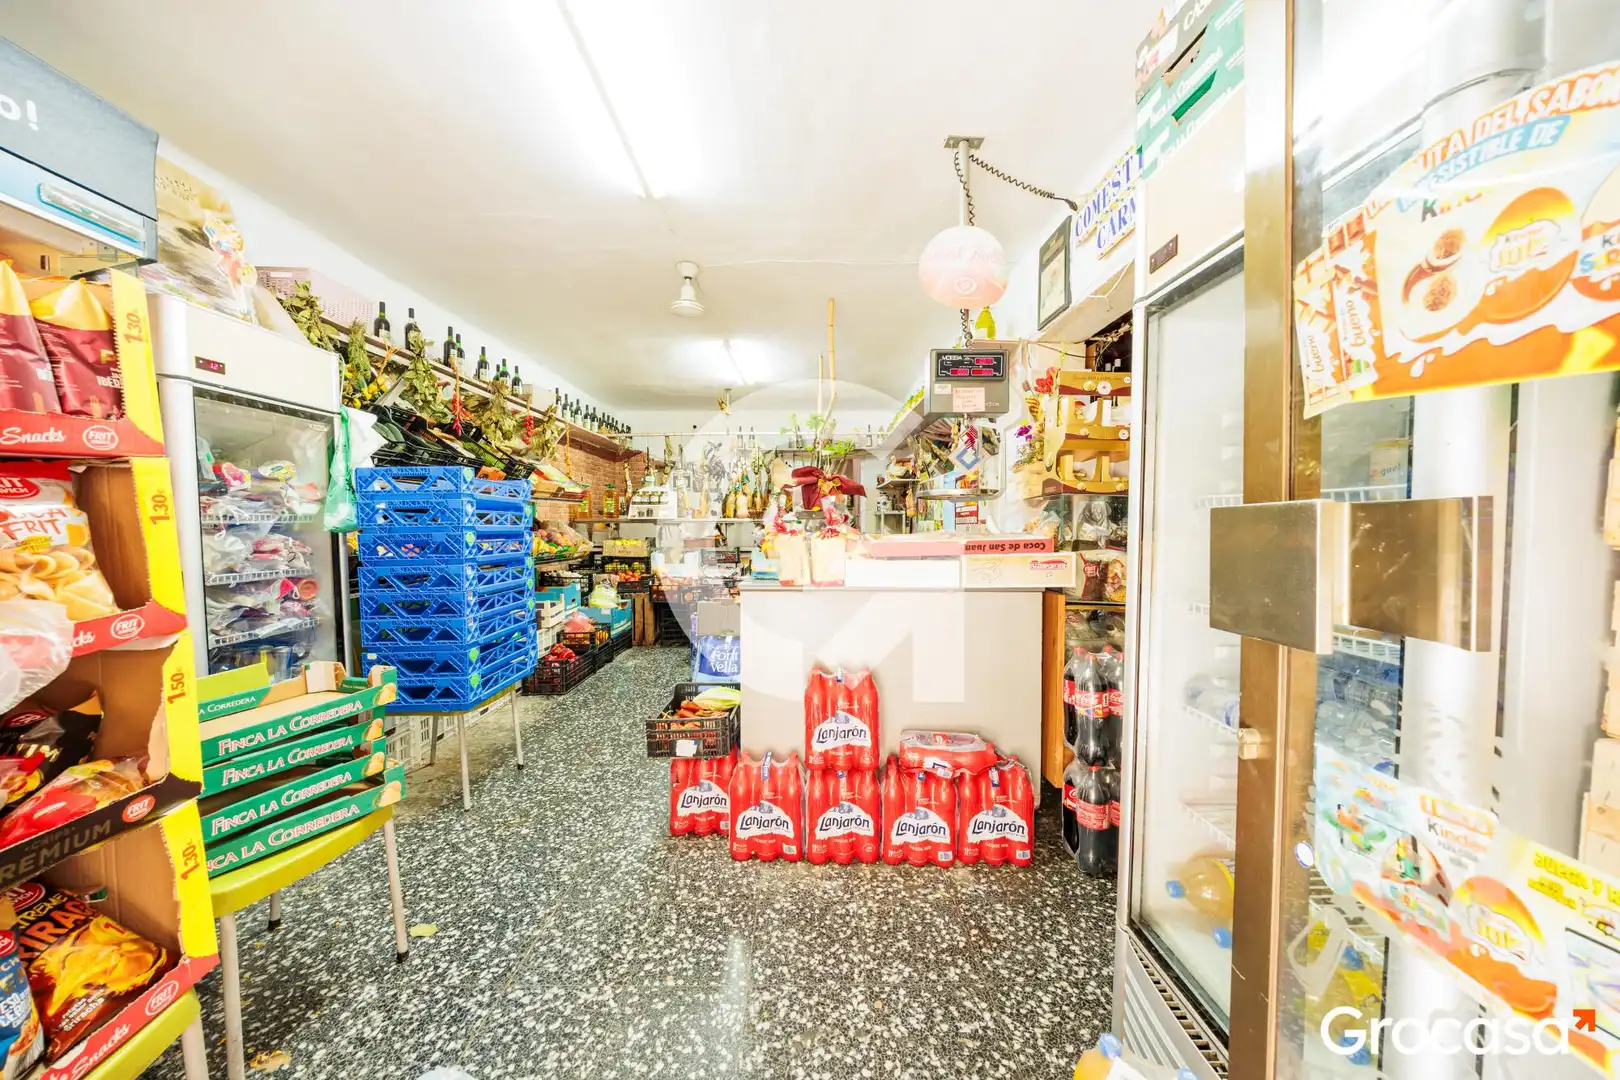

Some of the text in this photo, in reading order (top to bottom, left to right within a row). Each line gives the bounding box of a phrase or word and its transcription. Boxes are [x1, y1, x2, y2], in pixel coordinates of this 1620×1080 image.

[1431, 119, 1565, 187] ESISTIBLE DE
[1075, 150, 1144, 238] COMESTI
[1097, 197, 1136, 249] CARN
[1, 426, 66, 445] Snacks
[2, 517, 61, 541] FRIT
[965, 542, 1046, 553] Coca de San Juan
[115, 617, 138, 632] FRIT
[710, 648, 739, 662] Font
[711, 662, 738, 673] Vella
[207, 696, 256, 713] CORREDERA
[218, 700, 363, 757] FINCA LA CORREDERA
[815, 725, 867, 744] Lanjarón
[221, 736, 353, 787] FINCA LA CORREDERA
[127, 797, 152, 816] FRIT
[211, 771, 352, 837] FINCA LA CORREDERA
[680, 791, 727, 809] Lanjarón
[740, 815, 789, 831] Lanjarón
[819, 814, 870, 832] Lanjarón
[896, 819, 946, 836] Lanjarón
[972, 818, 1025, 835] Lanjarón
[207, 803, 360, 870] NCA LA CORREDERA
[0, 819, 111, 880] REMIUM
[18, 893, 68, 929] TREME
[150, 985, 174, 1009] FRIT
[71, 1023, 132, 1080] Snacks
